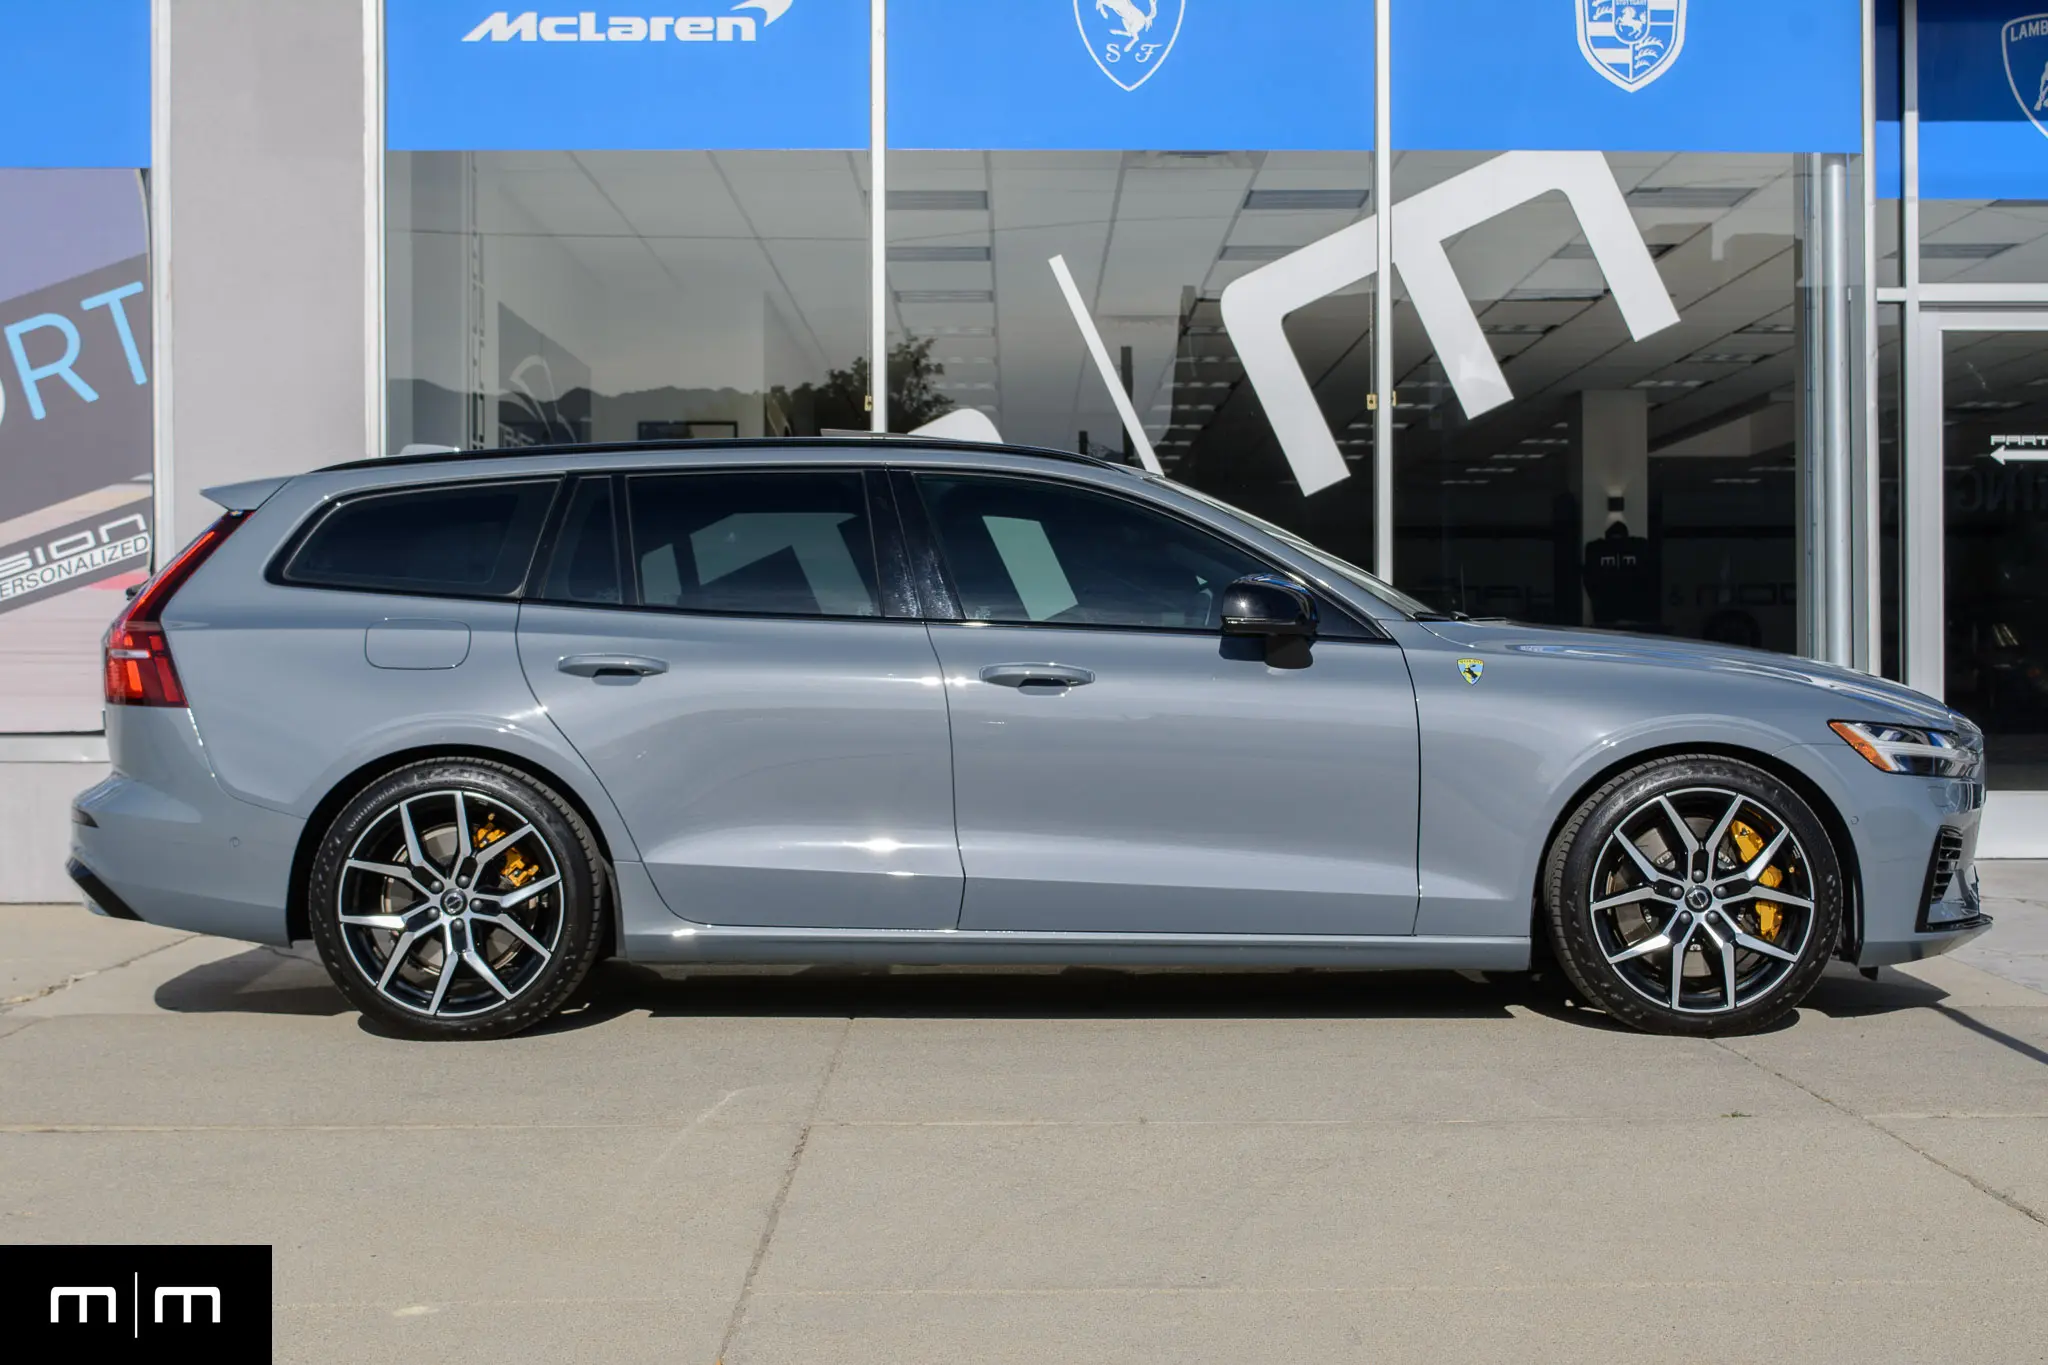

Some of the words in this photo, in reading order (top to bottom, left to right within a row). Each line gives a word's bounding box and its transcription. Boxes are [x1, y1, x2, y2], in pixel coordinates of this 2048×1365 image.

[461, 12, 757, 41] McLaren
[1105, 43, 1121, 63] S
[1134, 43, 1163, 63] F
[0, 281, 148, 428] RT
